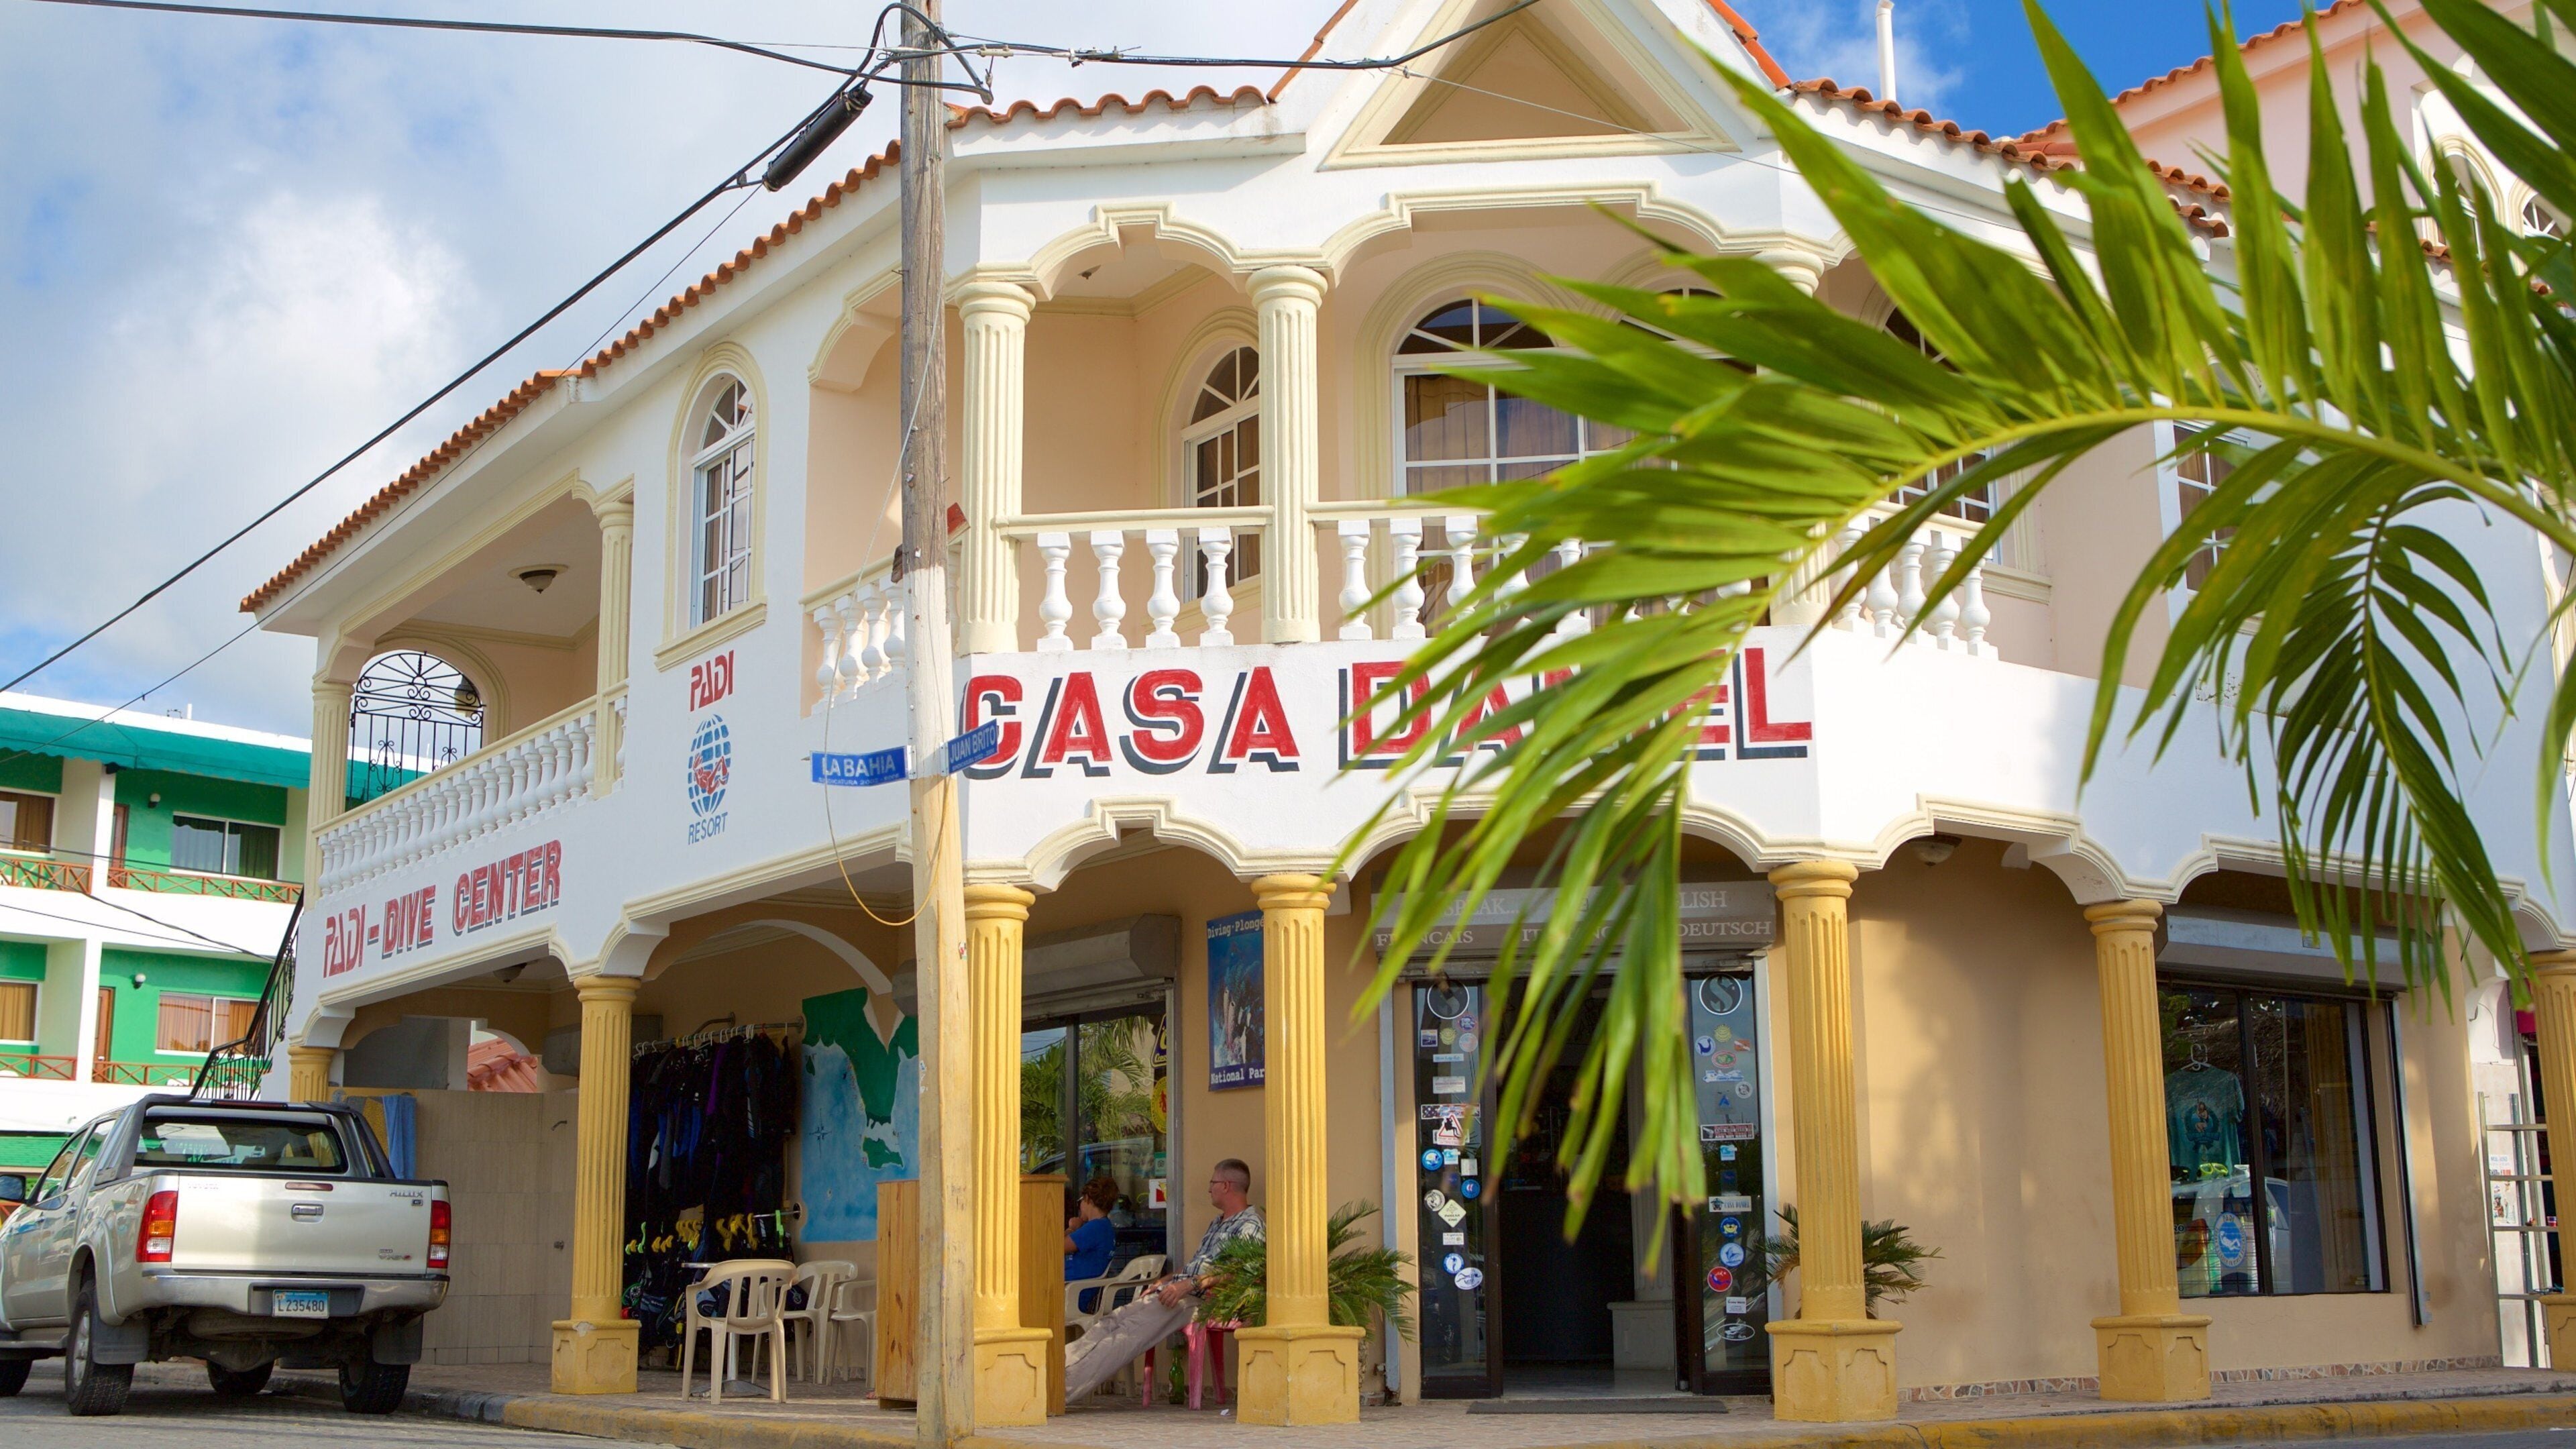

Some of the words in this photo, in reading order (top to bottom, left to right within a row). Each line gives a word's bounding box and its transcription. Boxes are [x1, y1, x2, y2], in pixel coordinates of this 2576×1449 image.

[690, 650, 734, 712] PADI
[962, 666, 1301, 780] CASA
[1339, 647, 1812, 770] DAEL
[950, 737, 971, 763] JUAN
[973, 725, 996, 753] BRITO
[822, 757, 841, 776] LA
[843, 755, 896, 777] BAHIA
[688, 812, 729, 845] RESORT
[453, 839, 563, 937] CENTER
[1678, 921, 1772, 937] DEUTSCH
[1211, 1068, 1245, 1085] National
[1249, 1067, 1265, 1079] Par
